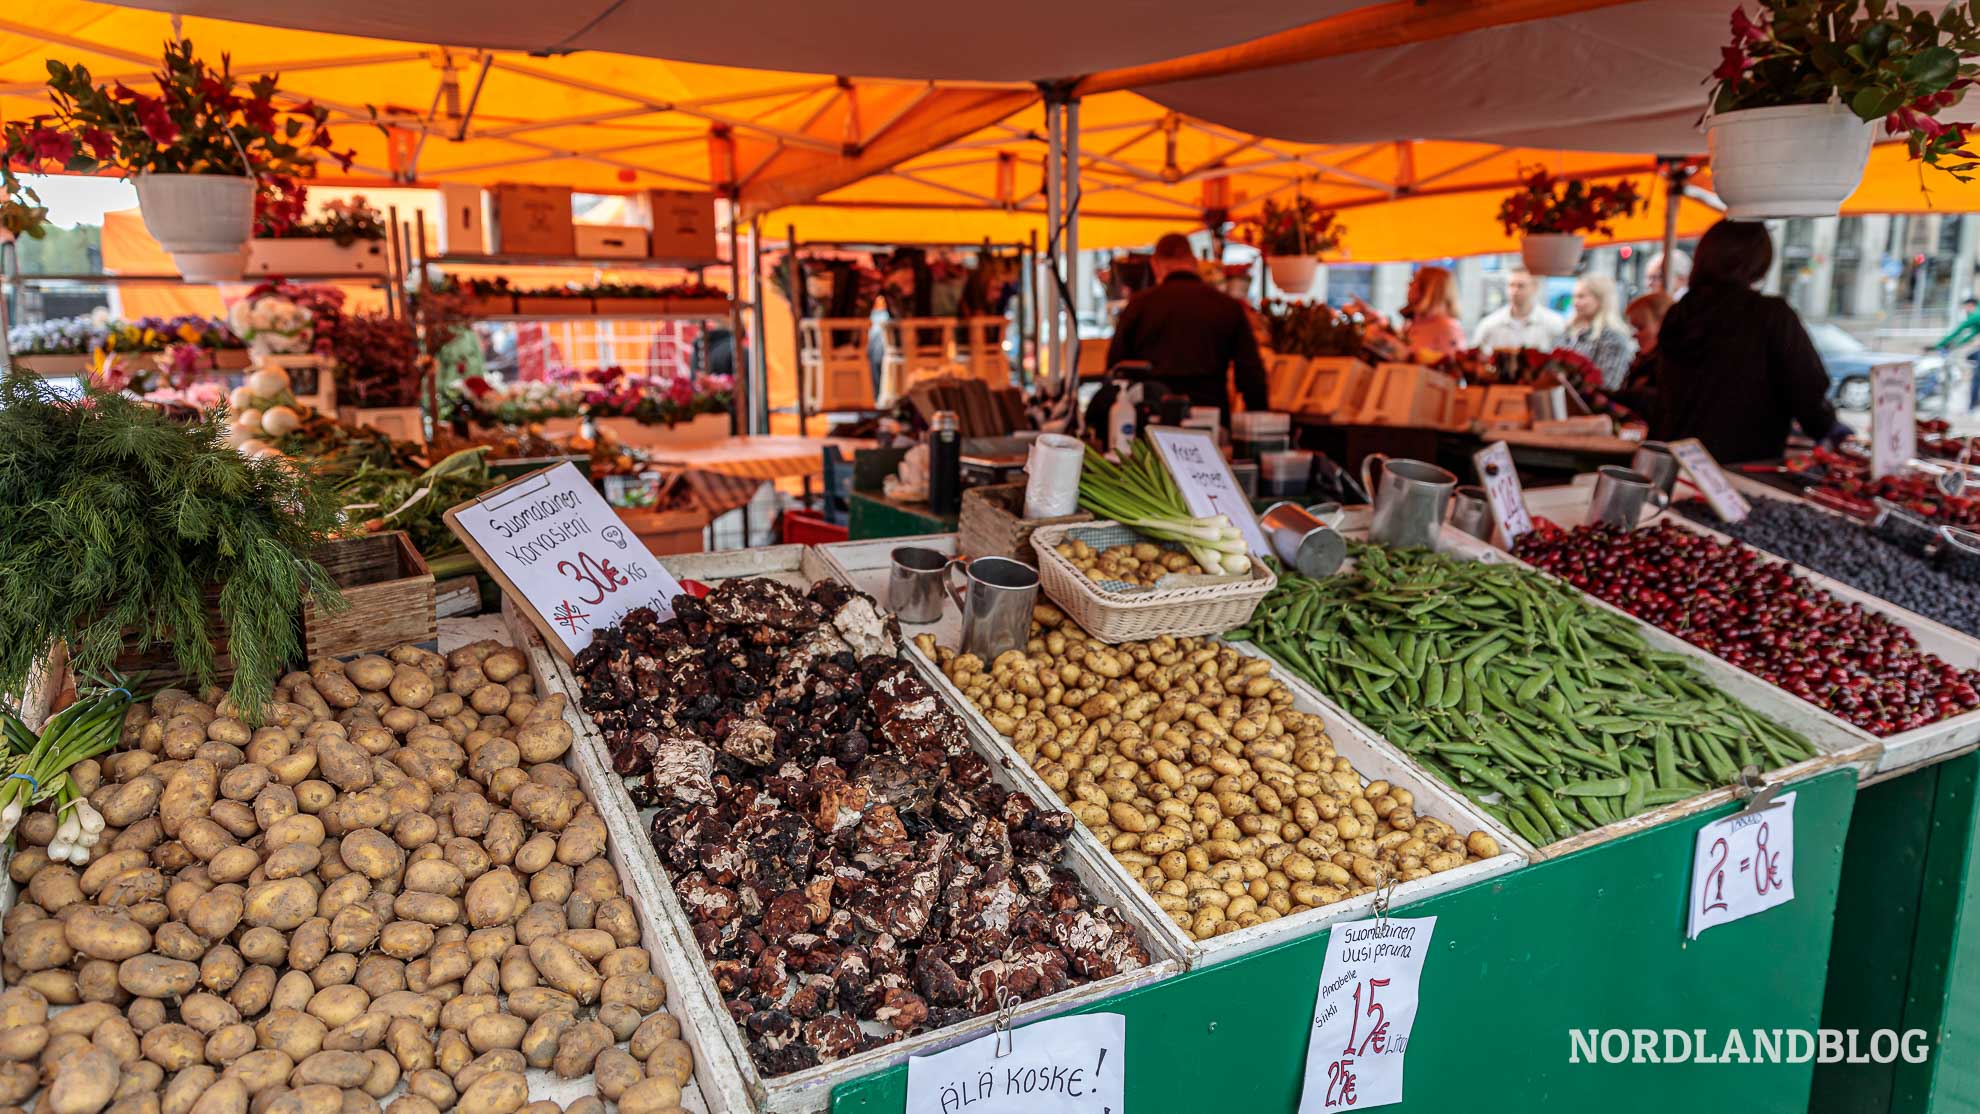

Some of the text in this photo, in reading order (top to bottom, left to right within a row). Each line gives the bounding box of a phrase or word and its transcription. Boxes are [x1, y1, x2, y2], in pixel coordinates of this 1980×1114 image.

[489, 488, 583, 539] Suomalainen
[505, 512, 592, 566] Korvasieni
[557, 551, 629, 605] 30€
[940, 1066, 993, 1114] ÄLÄ
